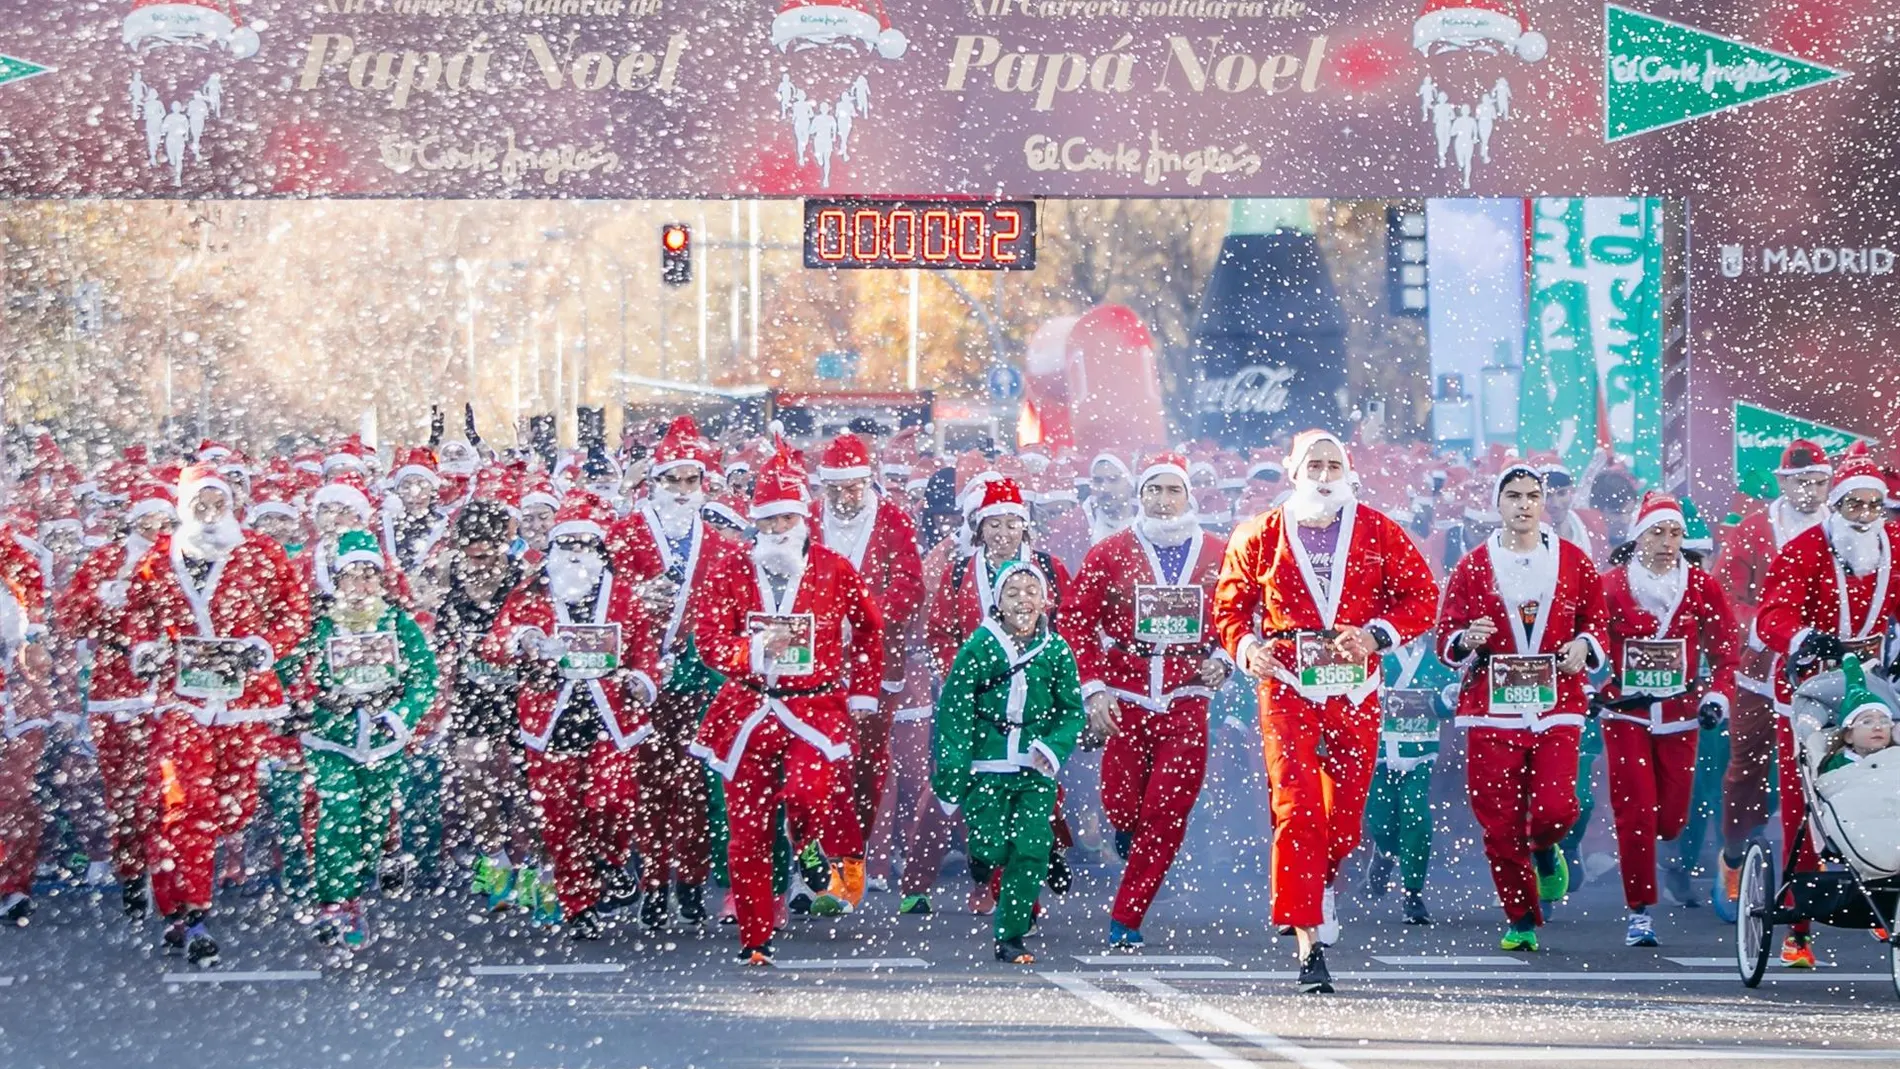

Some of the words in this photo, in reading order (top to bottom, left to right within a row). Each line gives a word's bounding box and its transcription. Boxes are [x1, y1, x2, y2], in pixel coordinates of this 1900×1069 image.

[1020, 0, 1128, 18] Carrera
[1137, 0, 1263, 18] solidaria
[1271, 0, 1306, 18] de
[300, 30, 493, 110] Papá
[512, 27, 688, 92] Noel
[941, 31, 1136, 111] Papá
[1156, 33, 1330, 93] Noel
[1611, 53, 1640, 84] El
[1640, 55, 1700, 84] Corte
[1702, 49, 1791, 94] Inglés
[1024, 134, 1061, 172] El
[1061, 136, 1141, 172] Corte
[1145, 128, 1262, 187] Inglés
[819, 209, 1021, 262] 00:00:02
[1763, 247, 1894, 274] MADRID
[1315, 665, 1355, 685] 3565
[1635, 670, 1673, 687] 3419
[1504, 686, 1540, 703] 6891
